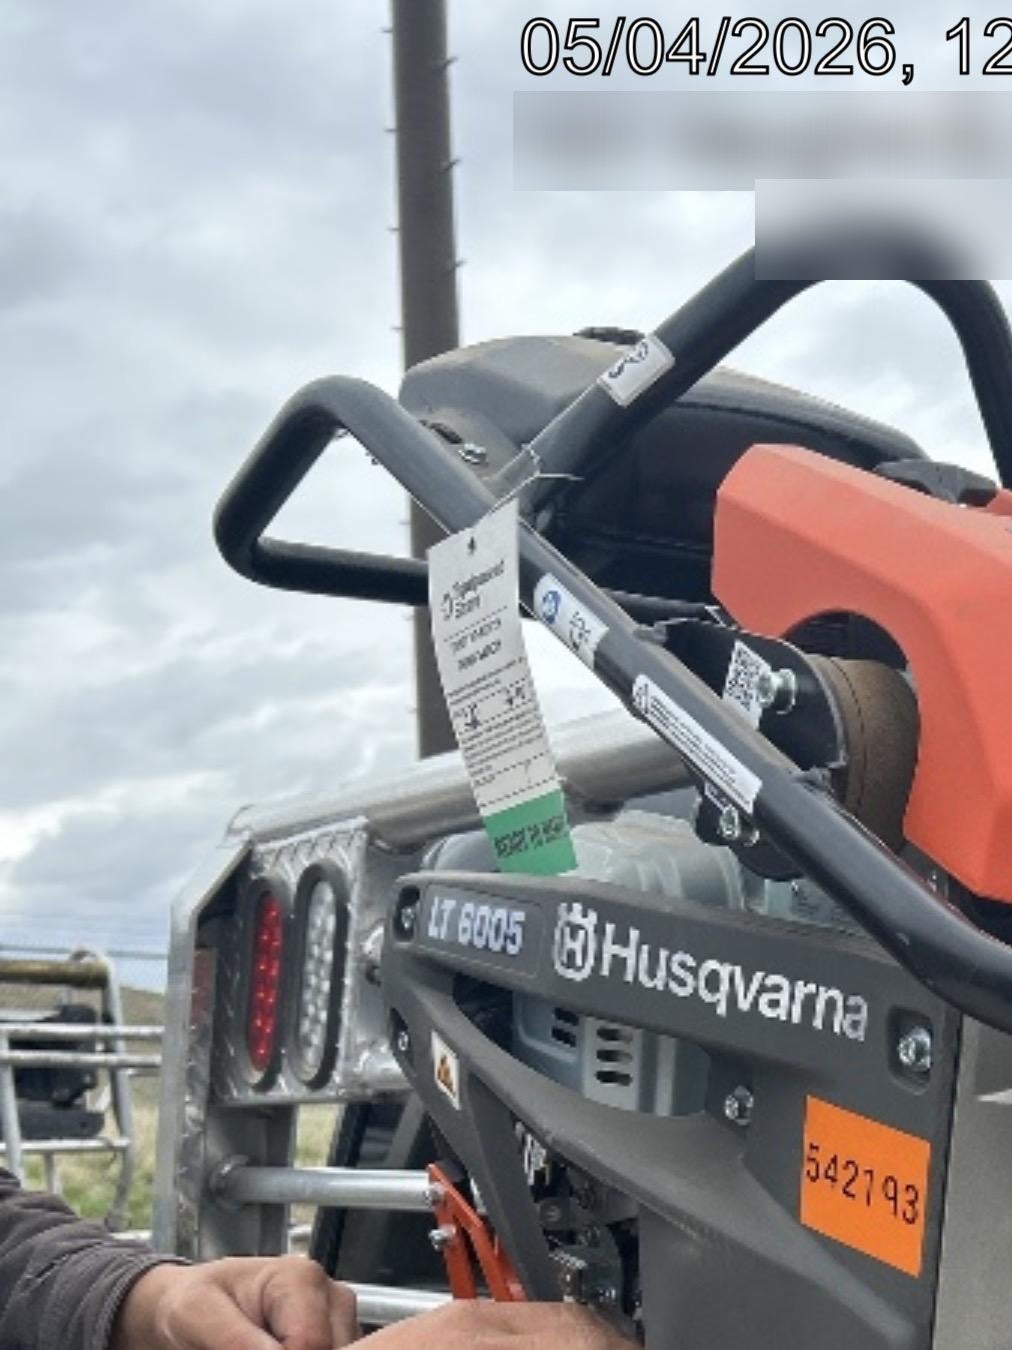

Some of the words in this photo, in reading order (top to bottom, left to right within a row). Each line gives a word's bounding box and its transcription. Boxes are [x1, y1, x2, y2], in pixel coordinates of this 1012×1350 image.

[427, 895, 457, 940] LT
[458, 902, 526, 956] 6005
[600, 921, 869, 1042] Husqvarna
